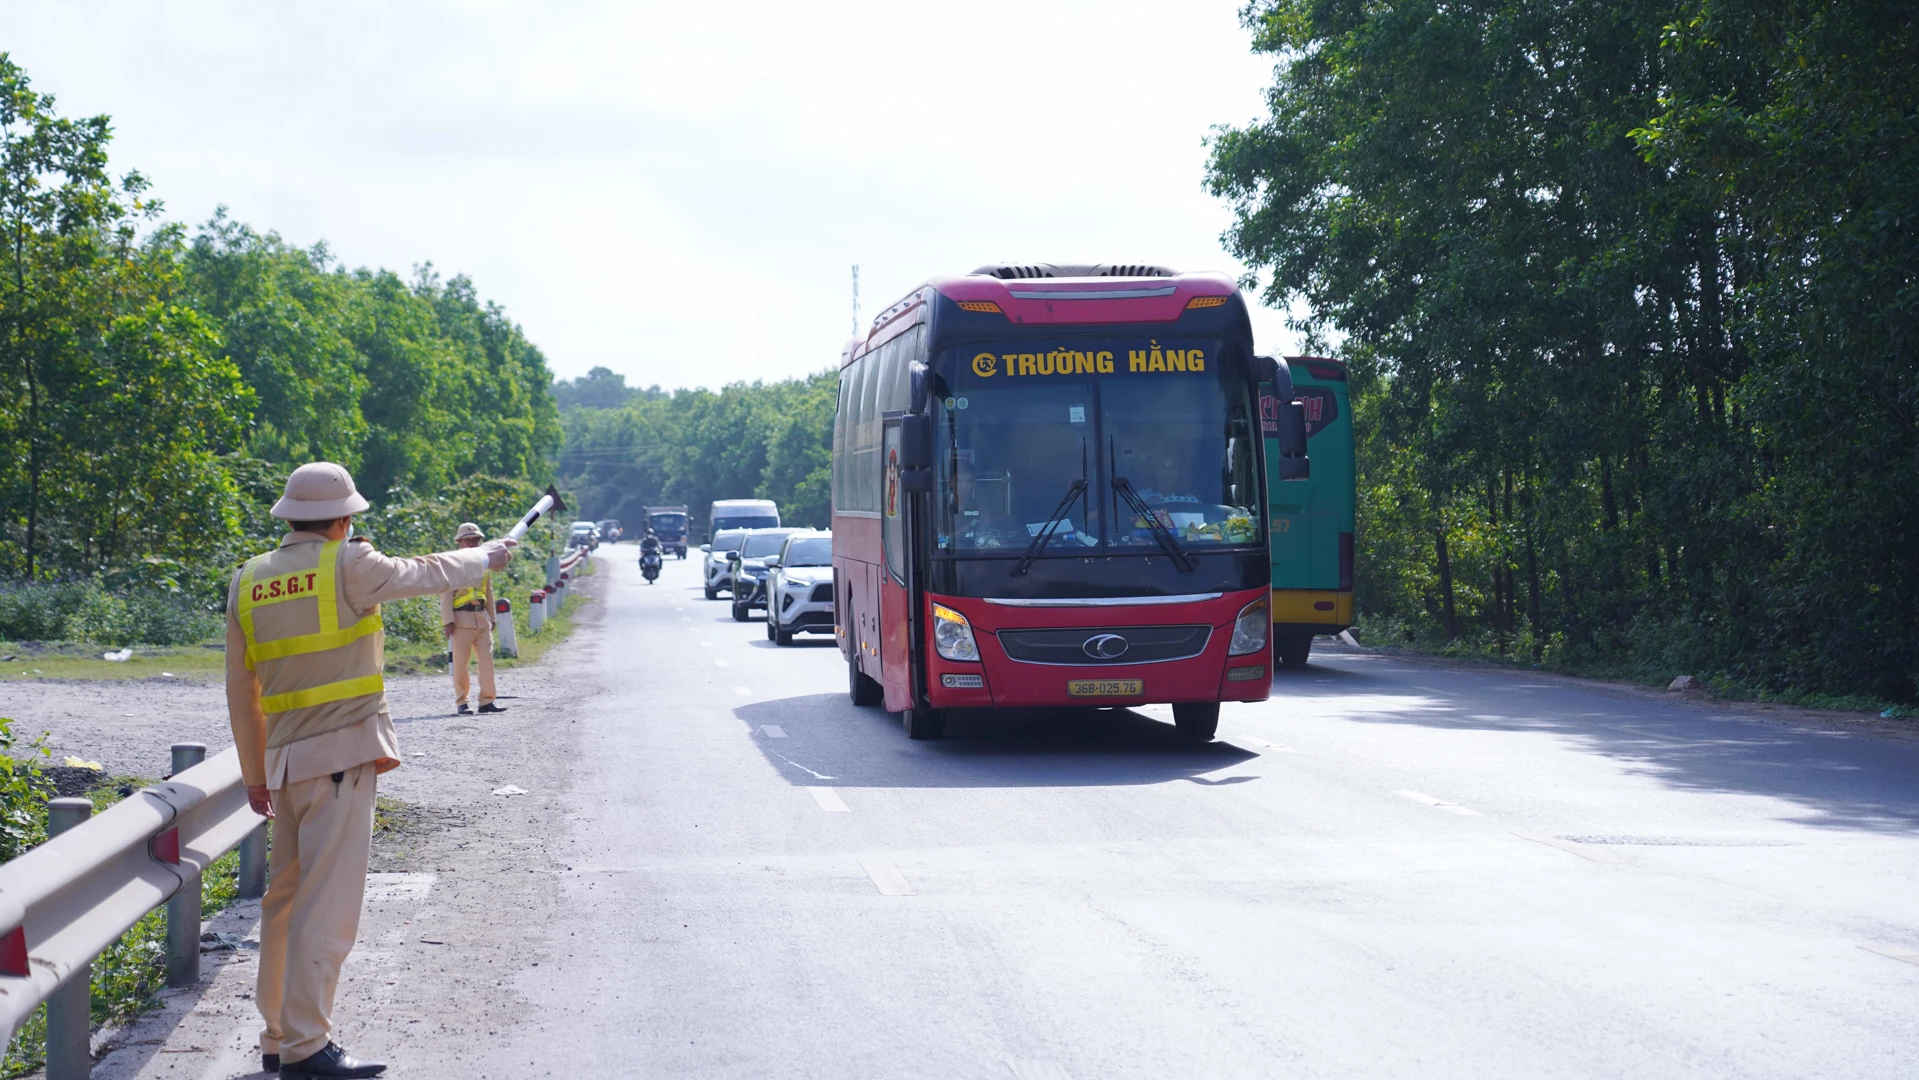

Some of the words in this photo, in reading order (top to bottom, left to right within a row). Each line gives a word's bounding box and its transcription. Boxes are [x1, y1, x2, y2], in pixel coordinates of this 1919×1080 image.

[1002, 346, 1114, 376] TRƯỜNG
[1129, 339, 1205, 372] HẰNG
[252, 573, 316, 602] C.S.G.T
[1075, 683, 1136, 694] 36B-025.76
